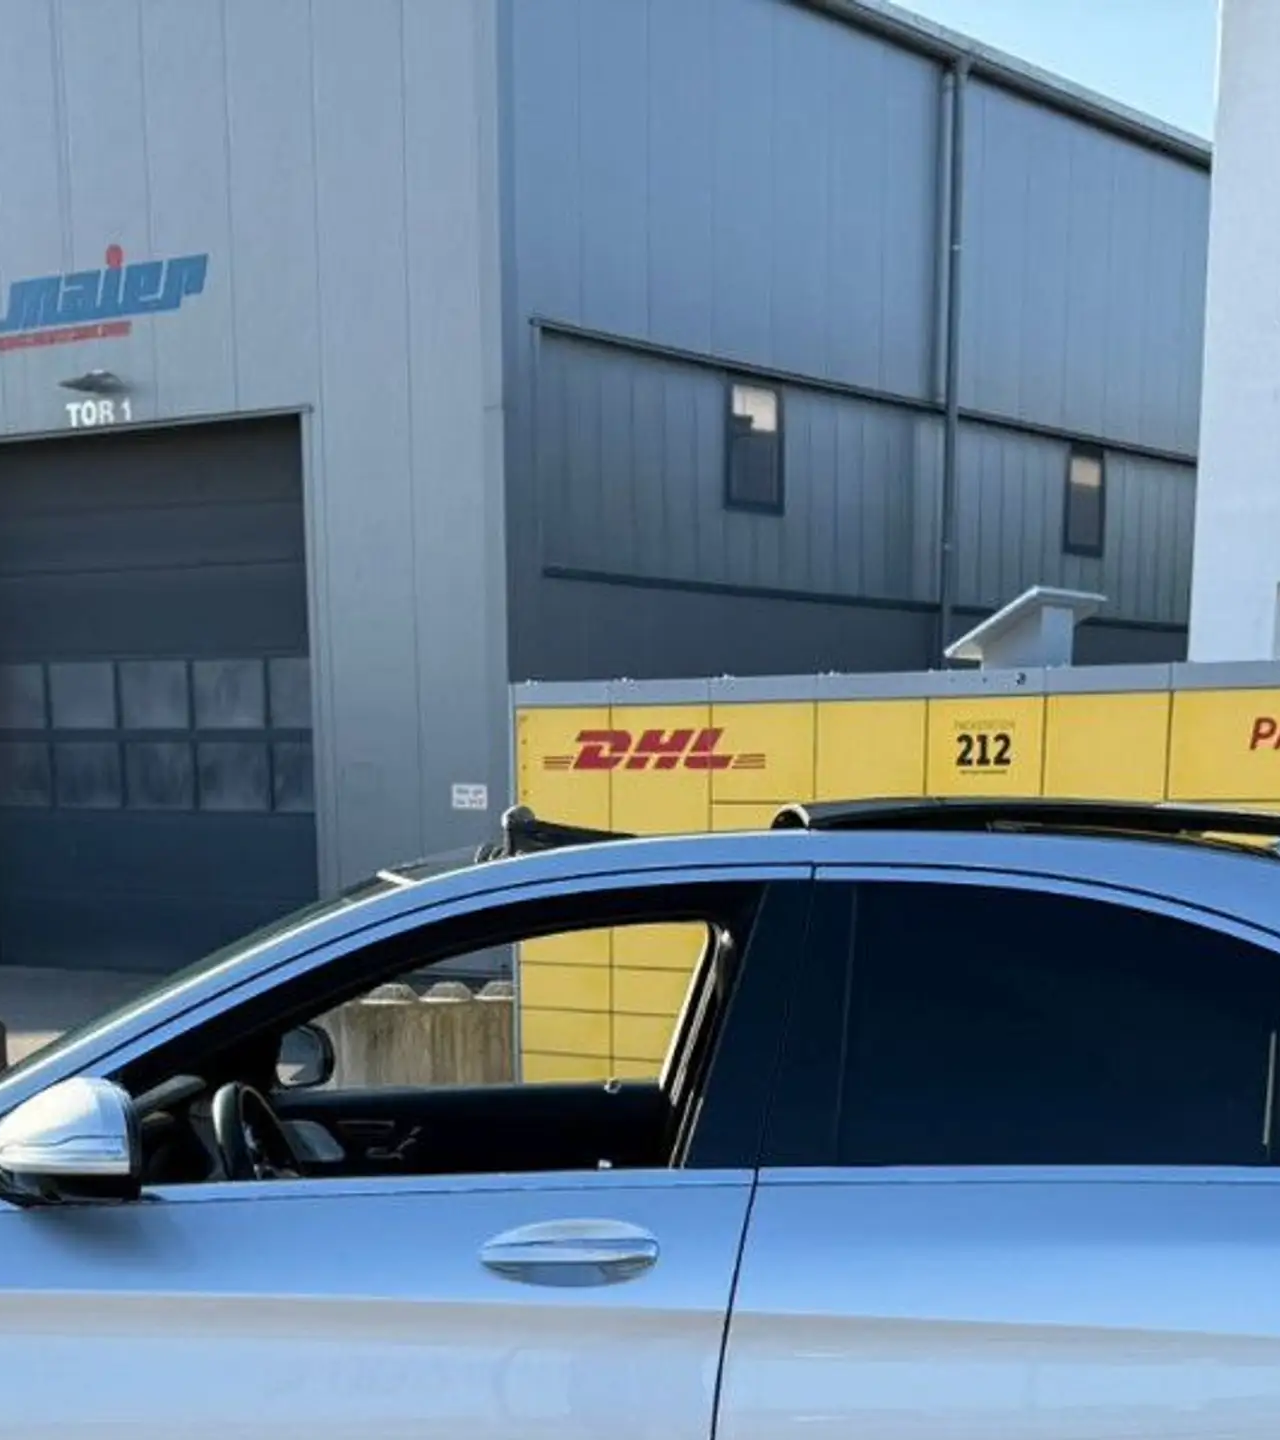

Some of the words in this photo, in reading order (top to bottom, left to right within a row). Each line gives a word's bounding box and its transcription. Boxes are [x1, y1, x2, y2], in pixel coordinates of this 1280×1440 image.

[66, 399, 115, 427] TOR
[121, 398, 132, 421] 1
[574, 728, 733, 769] DHL
[956, 733, 1011, 766] 212
